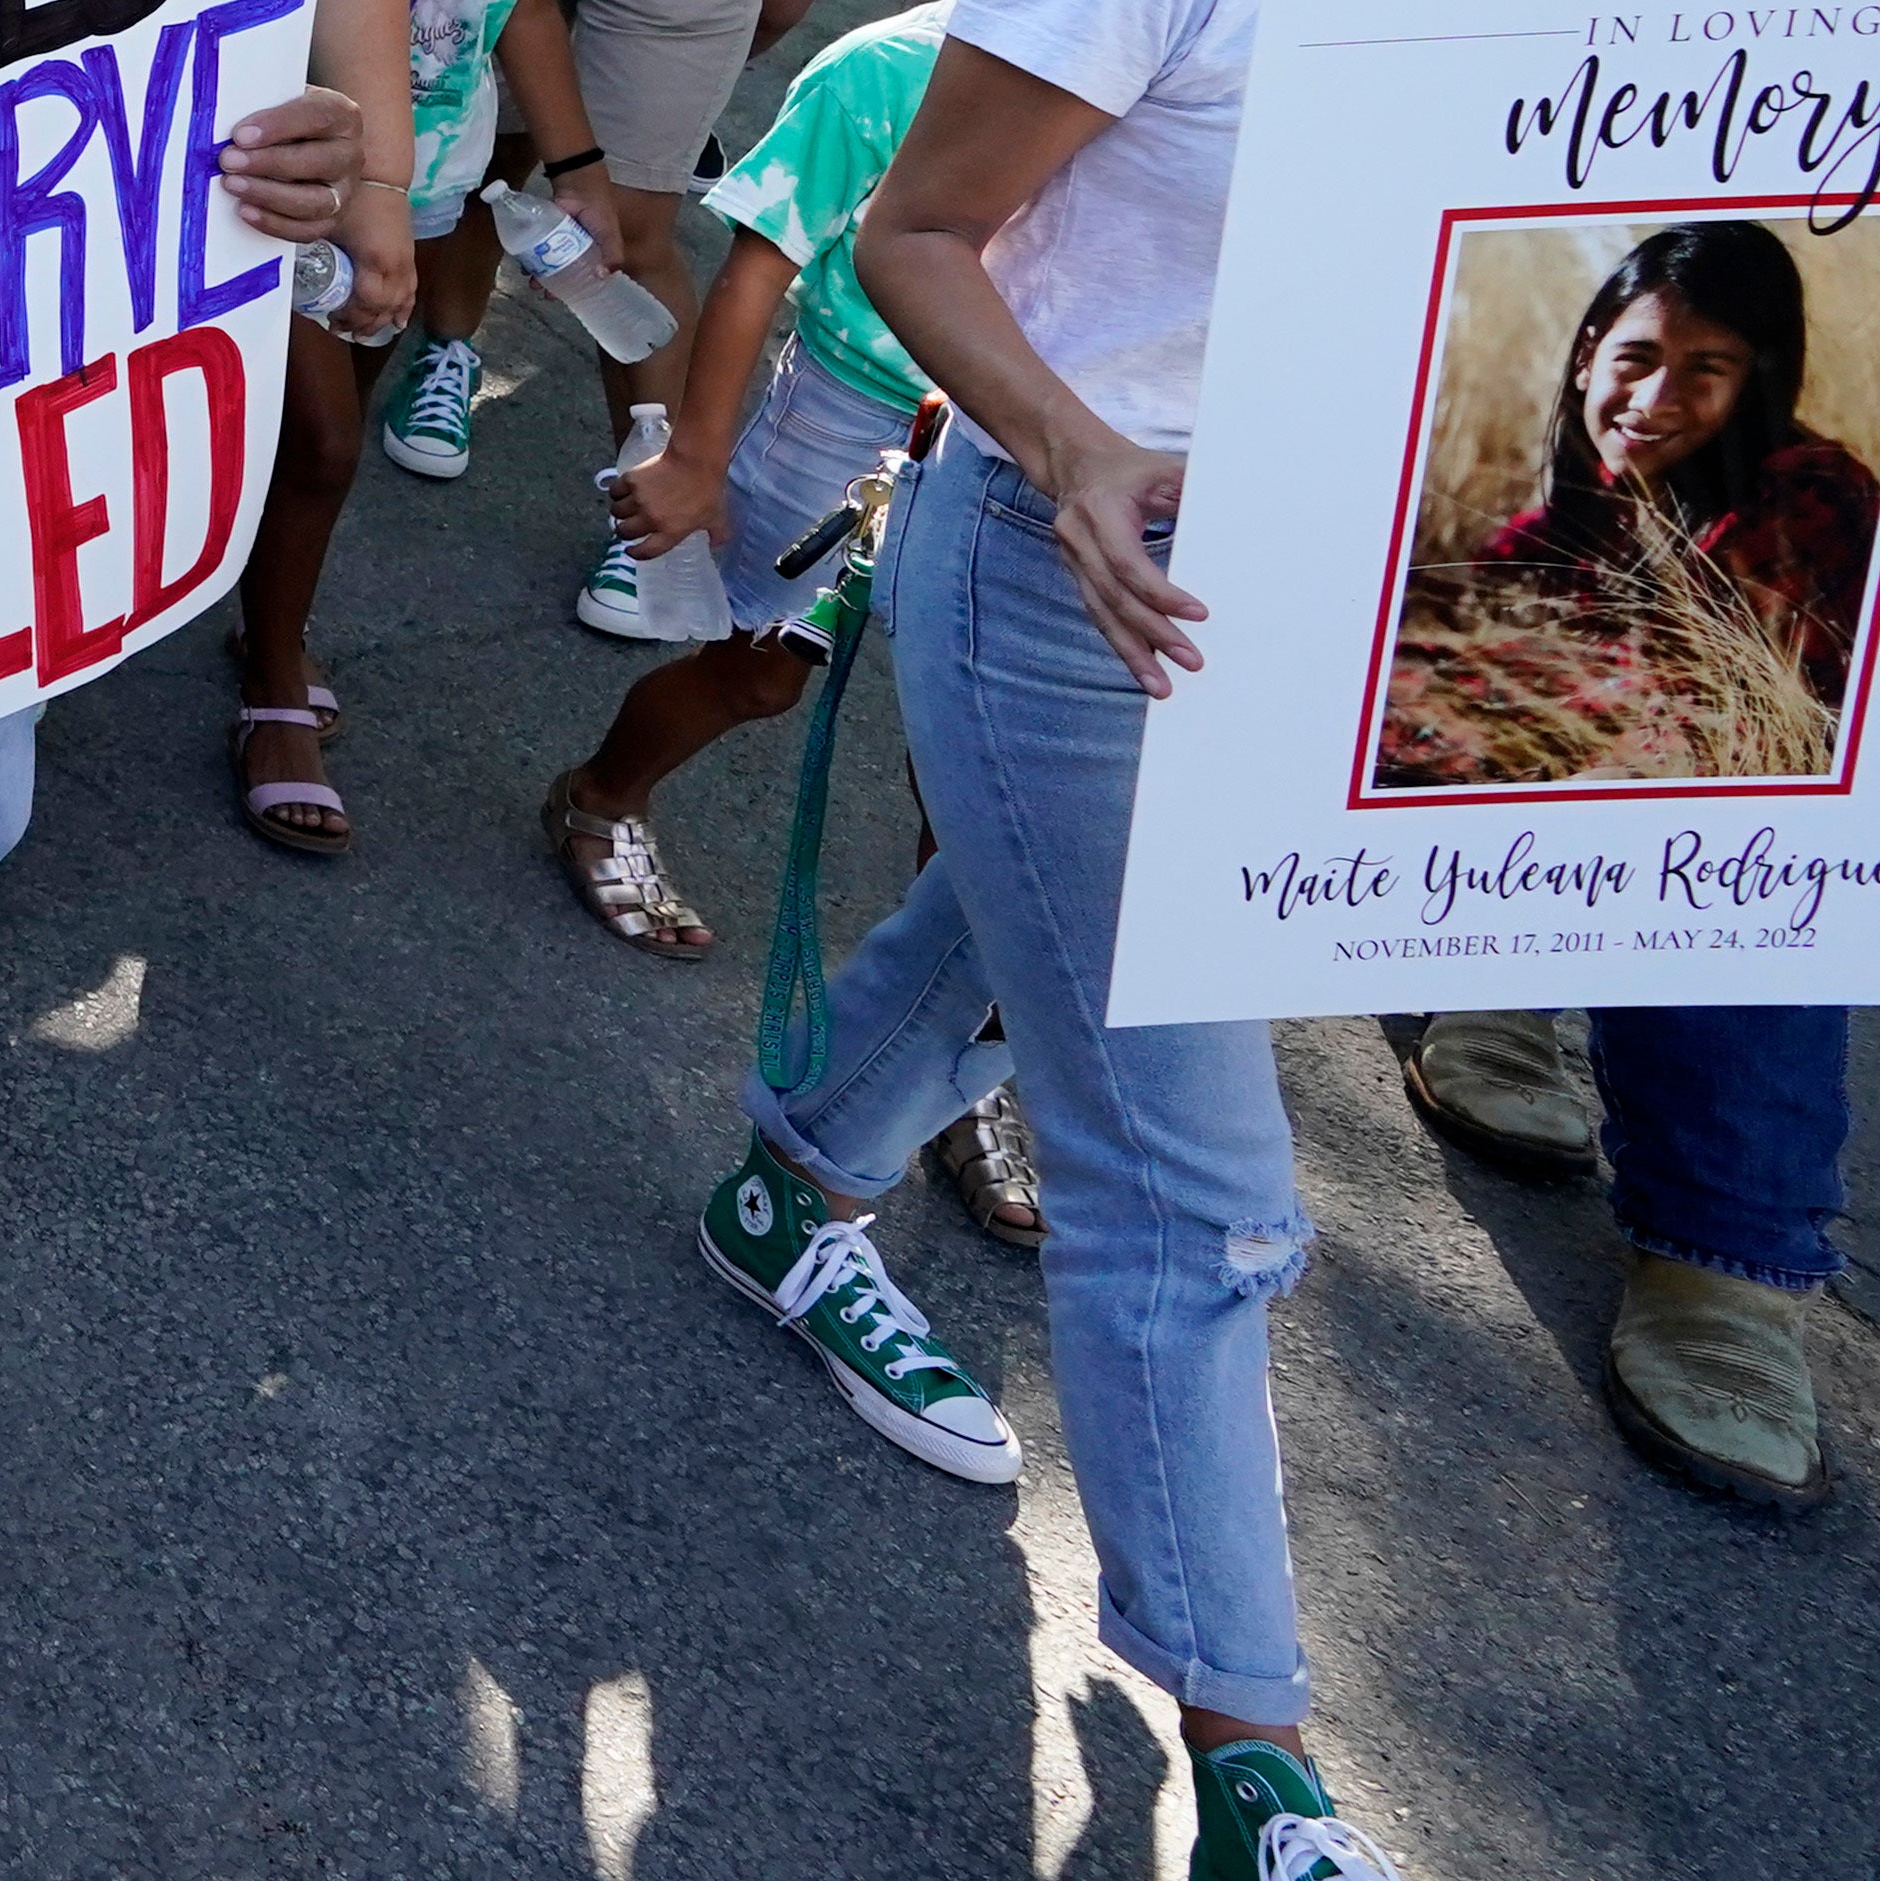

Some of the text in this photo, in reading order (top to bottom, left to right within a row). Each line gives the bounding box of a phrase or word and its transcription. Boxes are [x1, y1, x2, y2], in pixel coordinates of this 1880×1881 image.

[1584, 5, 1880, 47] IN LOVING
[1421, 830, 1637, 926] Yuleana
[1333, 934, 1500, 963] NOVEMBER
[1511, 933, 1540, 957] 17,
[1550, 931, 1605, 954] 2011
[1633, 928, 1703, 953] MAY
[1709, 928, 1746, 952] 24,
[1754, 927, 1818, 950] 2022
